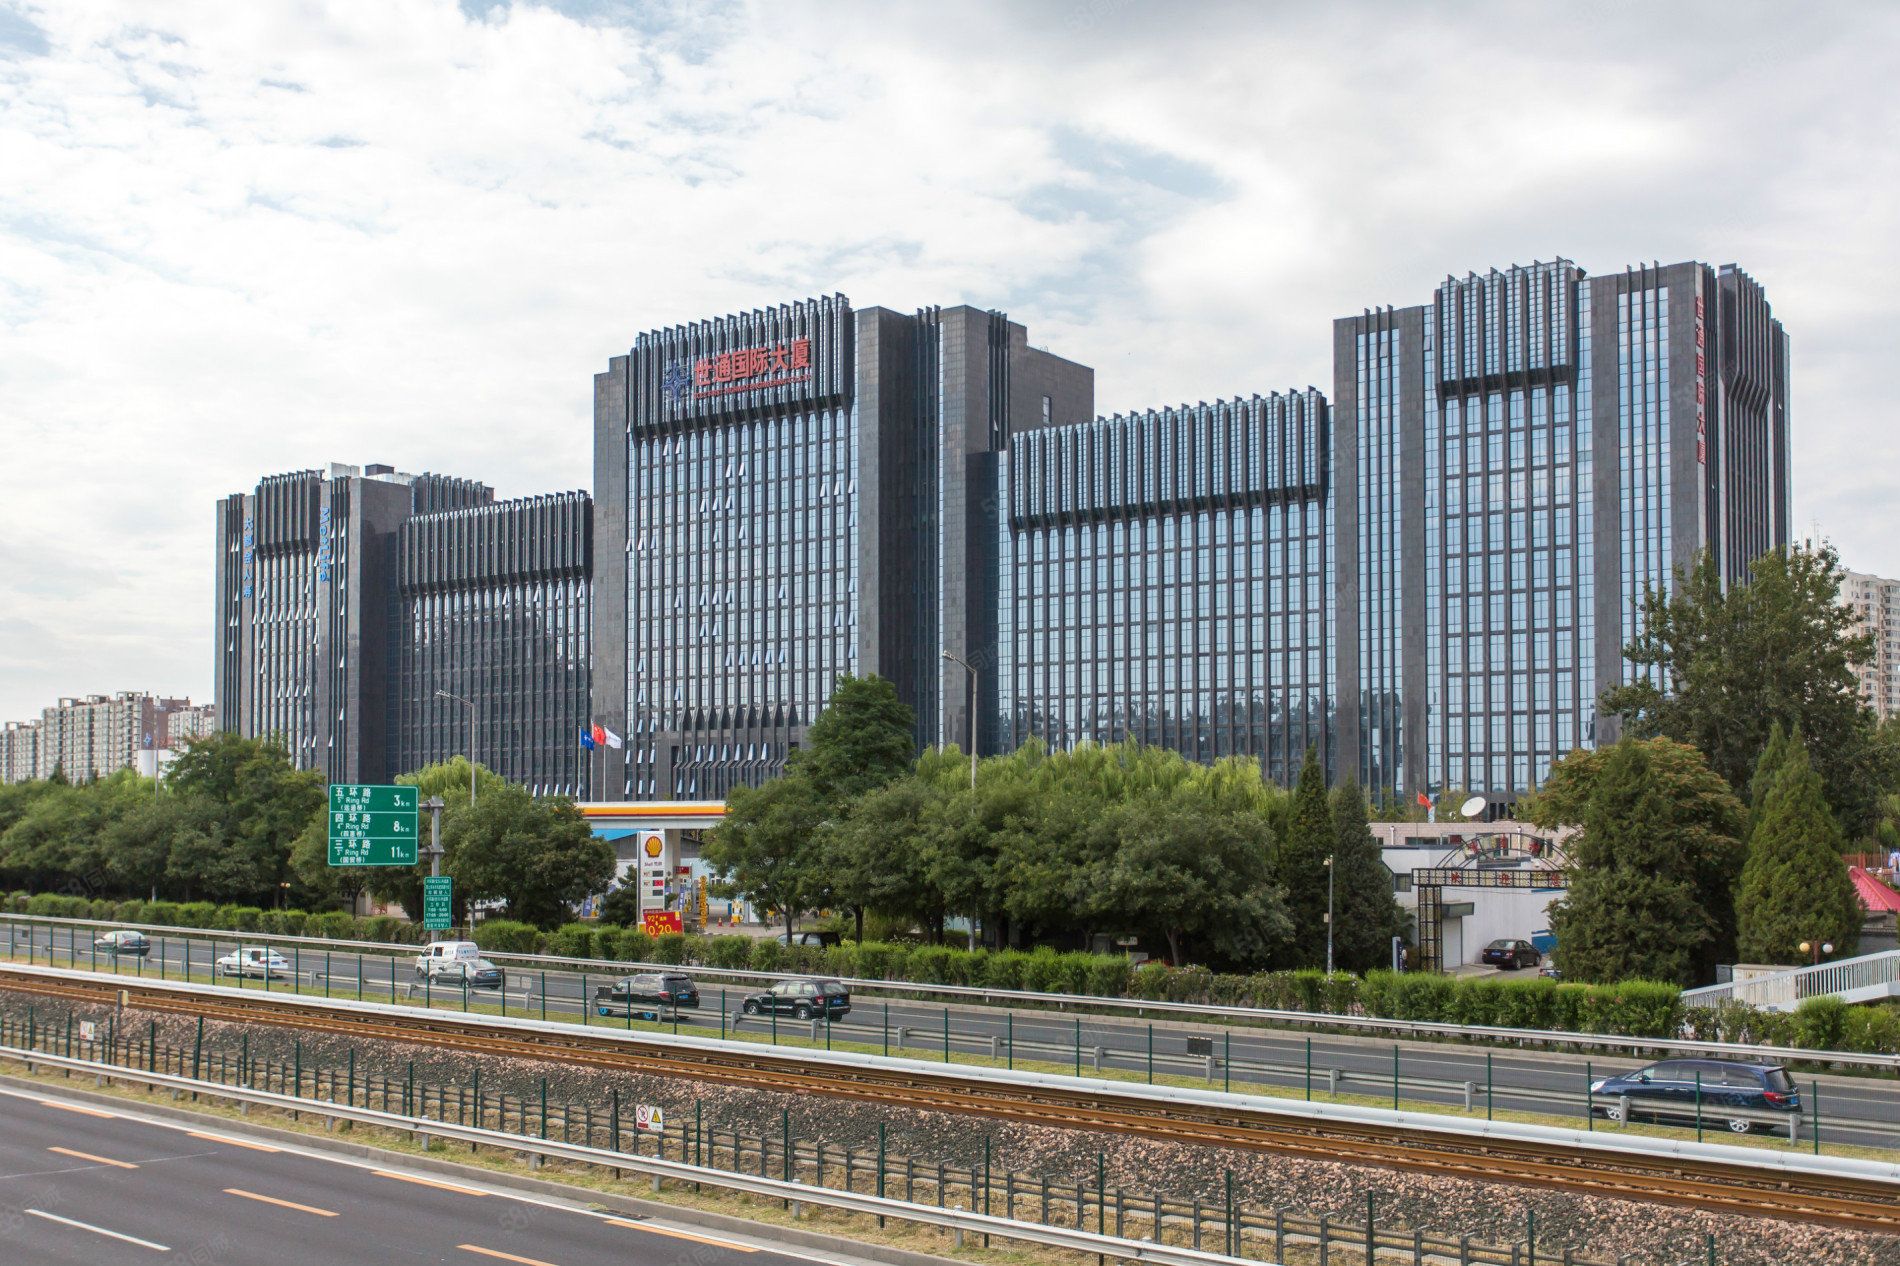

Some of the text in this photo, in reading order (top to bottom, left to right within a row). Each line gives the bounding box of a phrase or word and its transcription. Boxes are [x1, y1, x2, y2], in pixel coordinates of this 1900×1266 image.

[694, 338, 811, 386] 世通国际大厦
[335, 787, 371, 797] 五环路
[345, 797, 360, 805] Ring
[335, 813, 371, 823] 四环路
[345, 823, 360, 831] Ring
[334, 839, 371, 849] 三环路
[344, 849, 359, 857] Ring
[648, 924, 672, 936] 0.20
